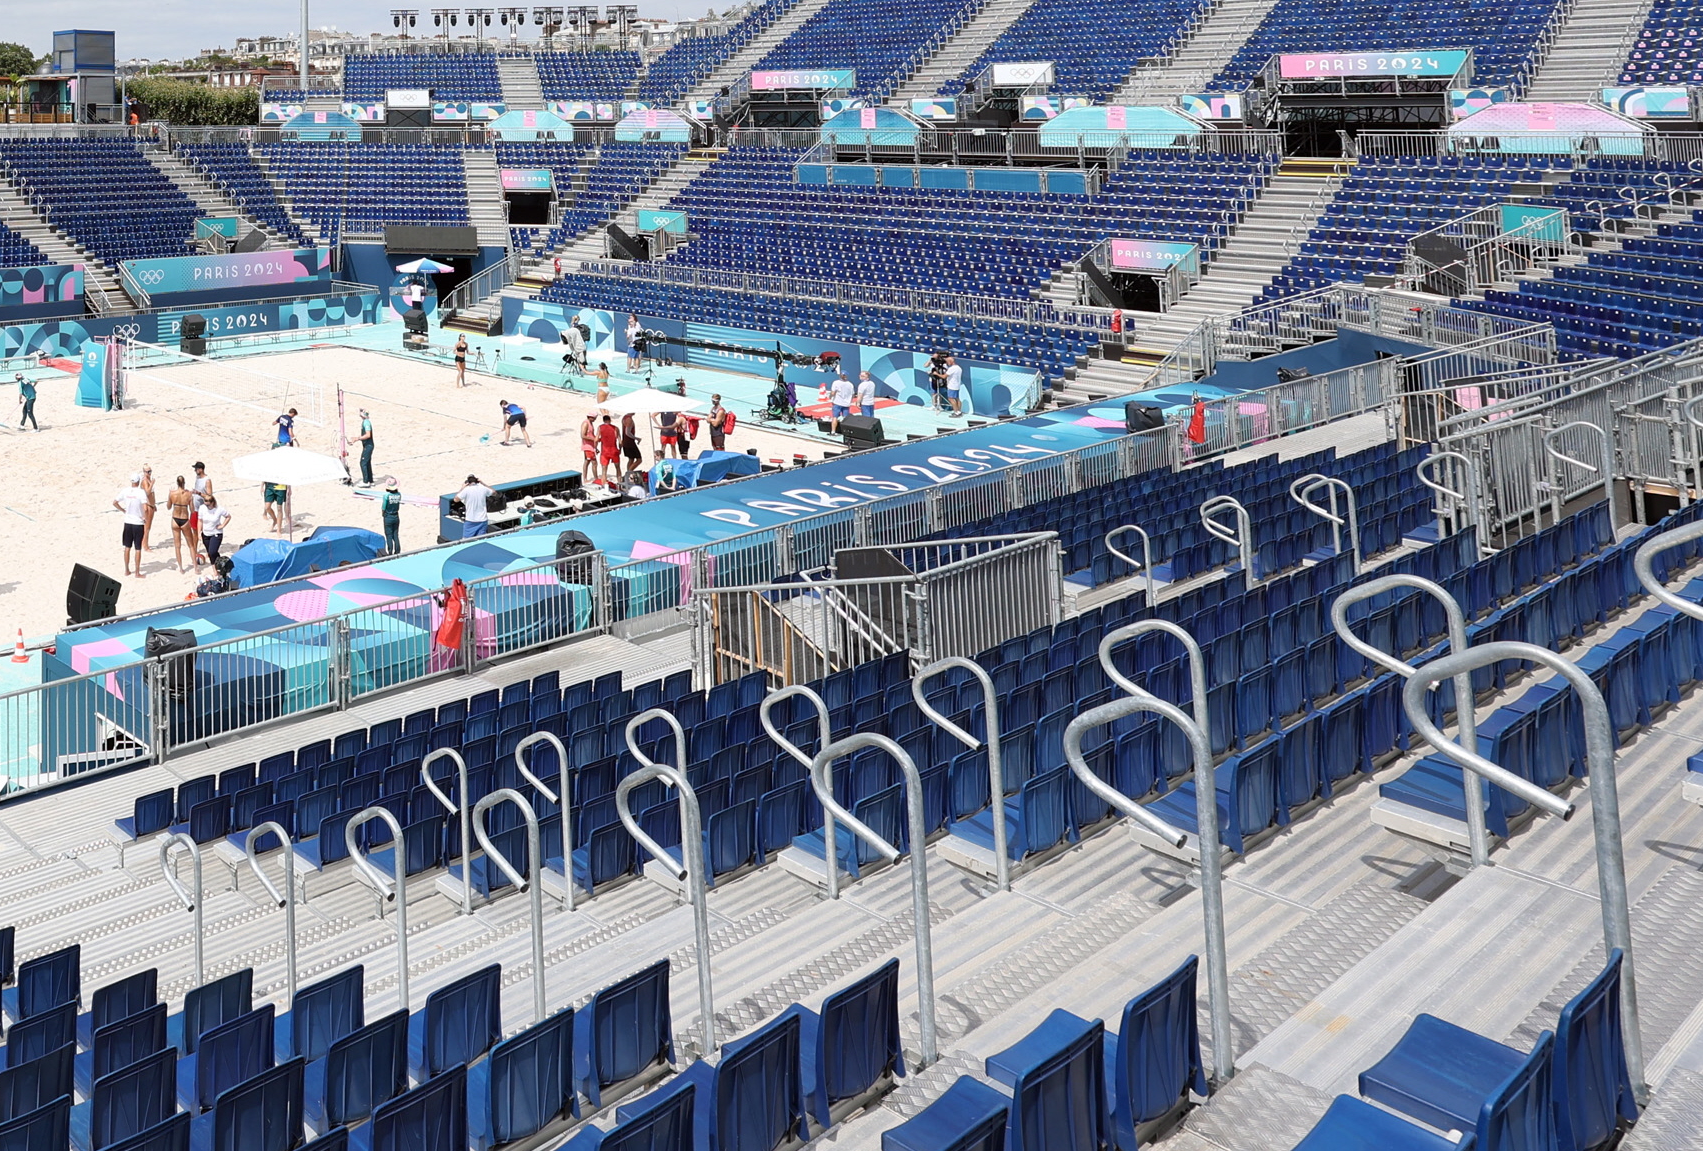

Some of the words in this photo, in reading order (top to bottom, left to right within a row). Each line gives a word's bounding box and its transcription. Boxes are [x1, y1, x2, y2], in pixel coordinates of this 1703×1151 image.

[1377, 57, 1439, 70] 2024
[804, 74, 837, 84] 2024
[244, 262, 283, 276] 2024
[226, 313, 268, 330] 2024
[890, 443, 1059, 484] 2024
